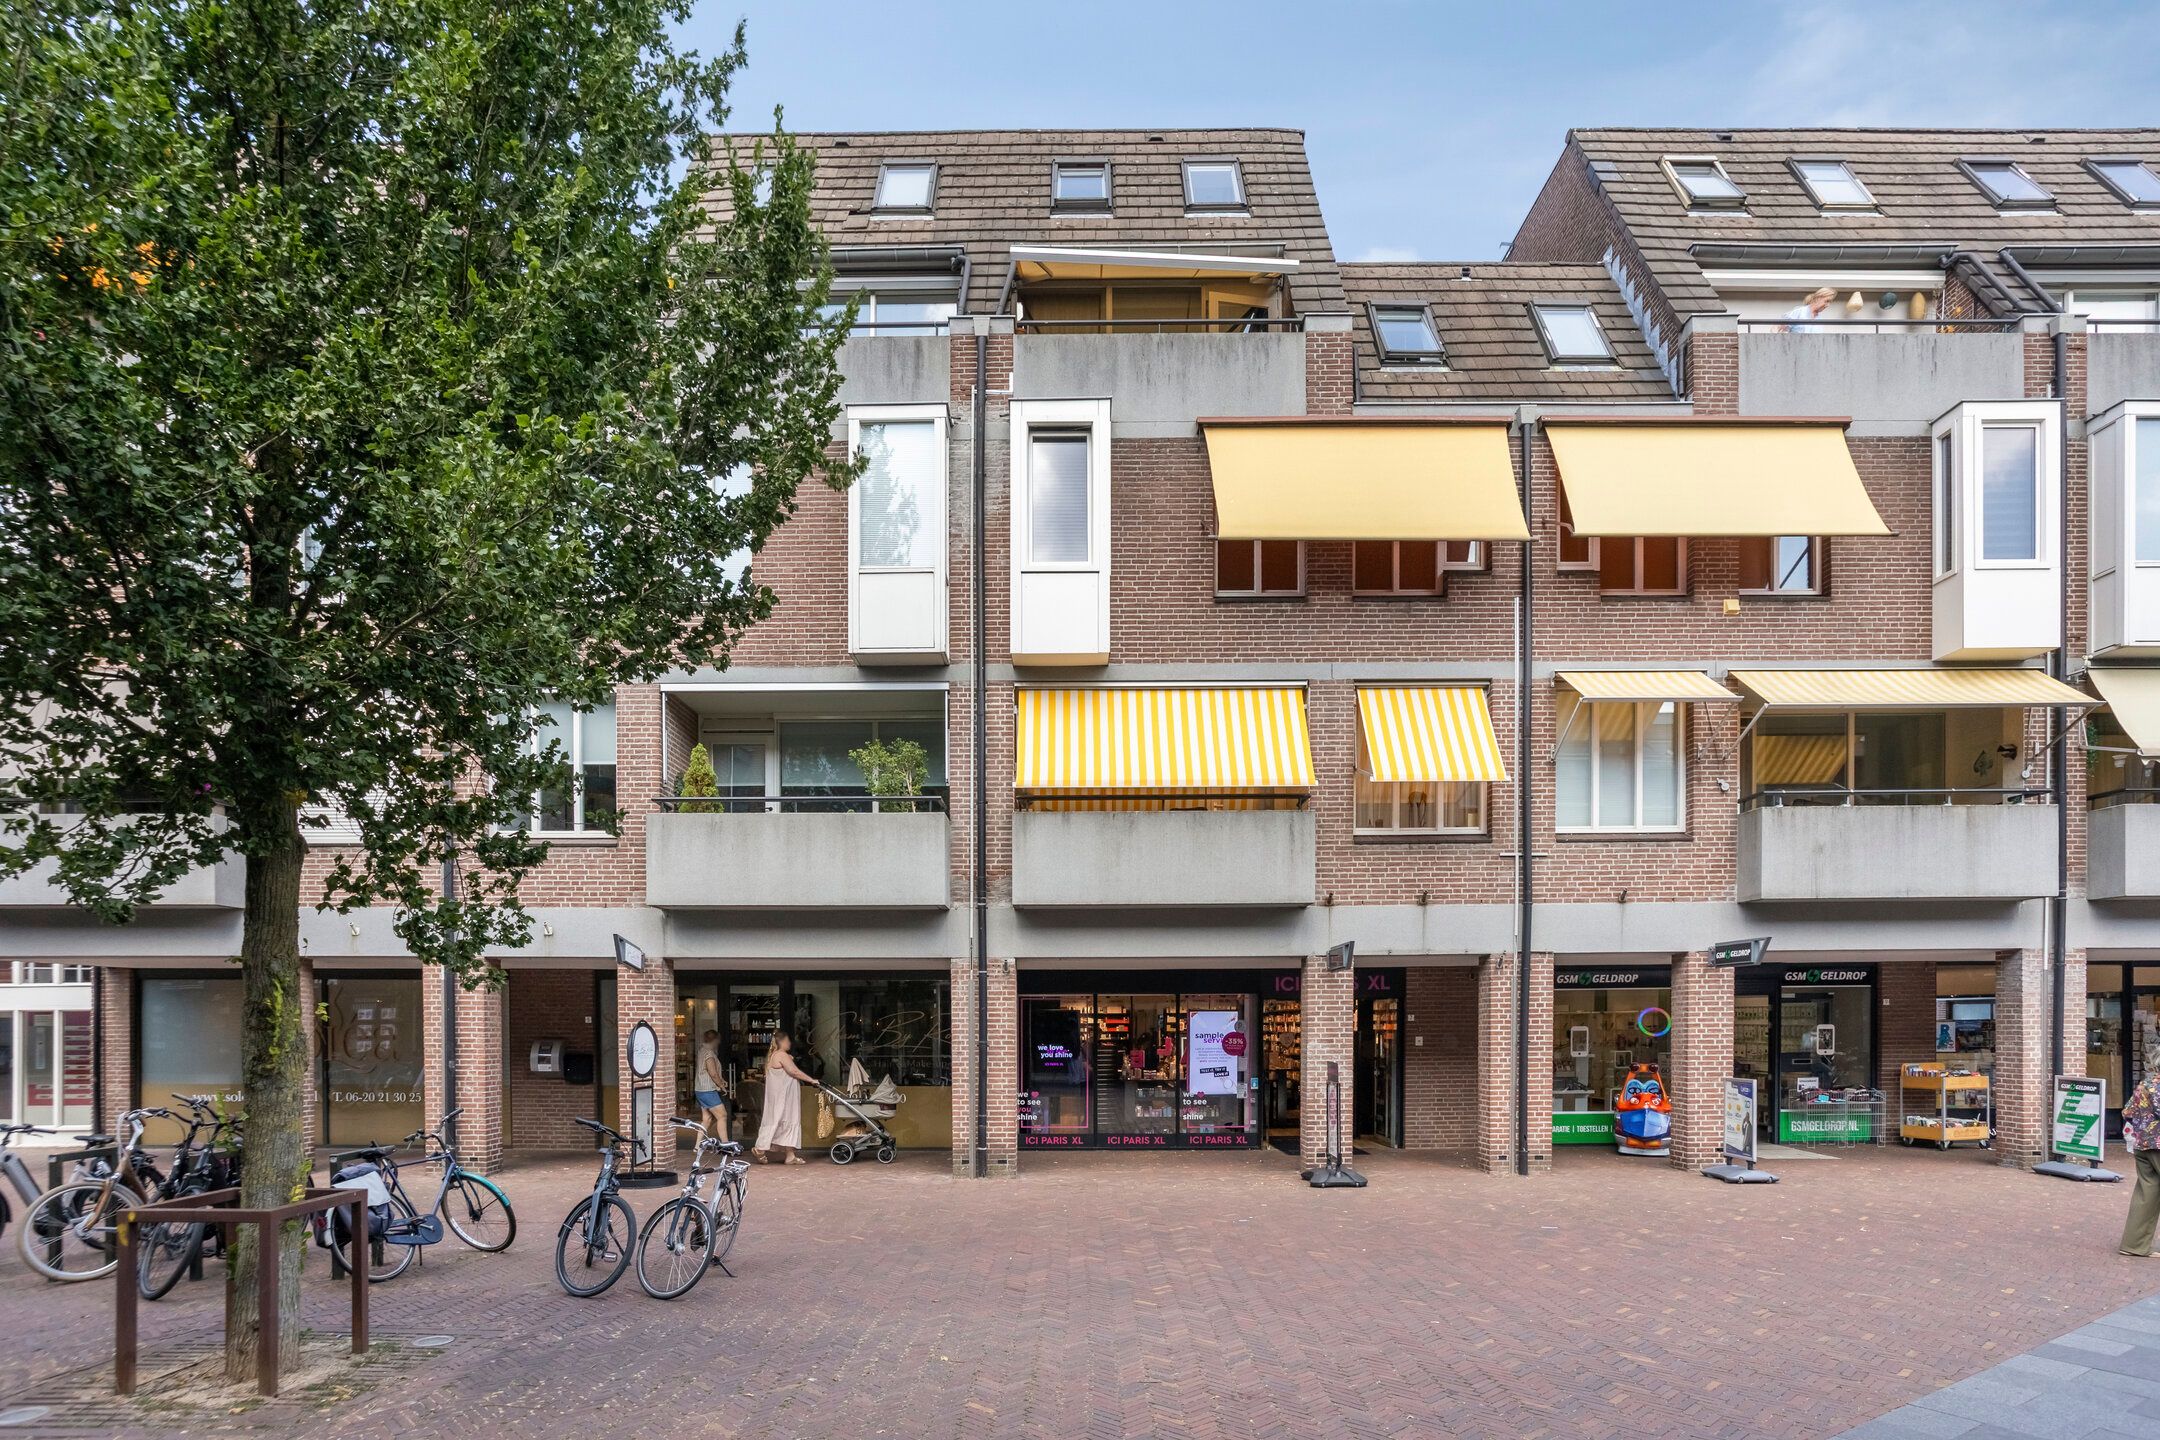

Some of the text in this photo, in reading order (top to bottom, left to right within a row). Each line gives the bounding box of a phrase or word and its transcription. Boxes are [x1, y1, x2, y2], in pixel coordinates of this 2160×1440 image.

[1716, 949, 1751, 959] GSM GELDROP
[1556, 973, 1639, 984] GSM GELDROP
[1784, 971, 1867, 981] GSM GELDROP
[1274, 976, 1300, 992] ICI
[1367, 975, 1391, 990] XL
[1195, 1032, 1224, 1040] sample
[1040, 1051, 1053, 1059] you
[346, 1091, 375, 1102] 06-20
[378, 1091, 390, 1102] 21
[393, 1091, 406, 1102] 30
[409, 1091, 422, 1102] 25
[1182, 1113, 1204, 1121] shine
[1577, 1125, 1608, 1133] TOESTELLEN
[1791, 1120, 1859, 1132] GSMGELDROP.NL
[1026, 1136, 1083, 1144] ICI PARIS XL
[1108, 1136, 1165, 1144] ICI PARIS XL
[1190, 1136, 1248, 1144] ICI PARIS XL
